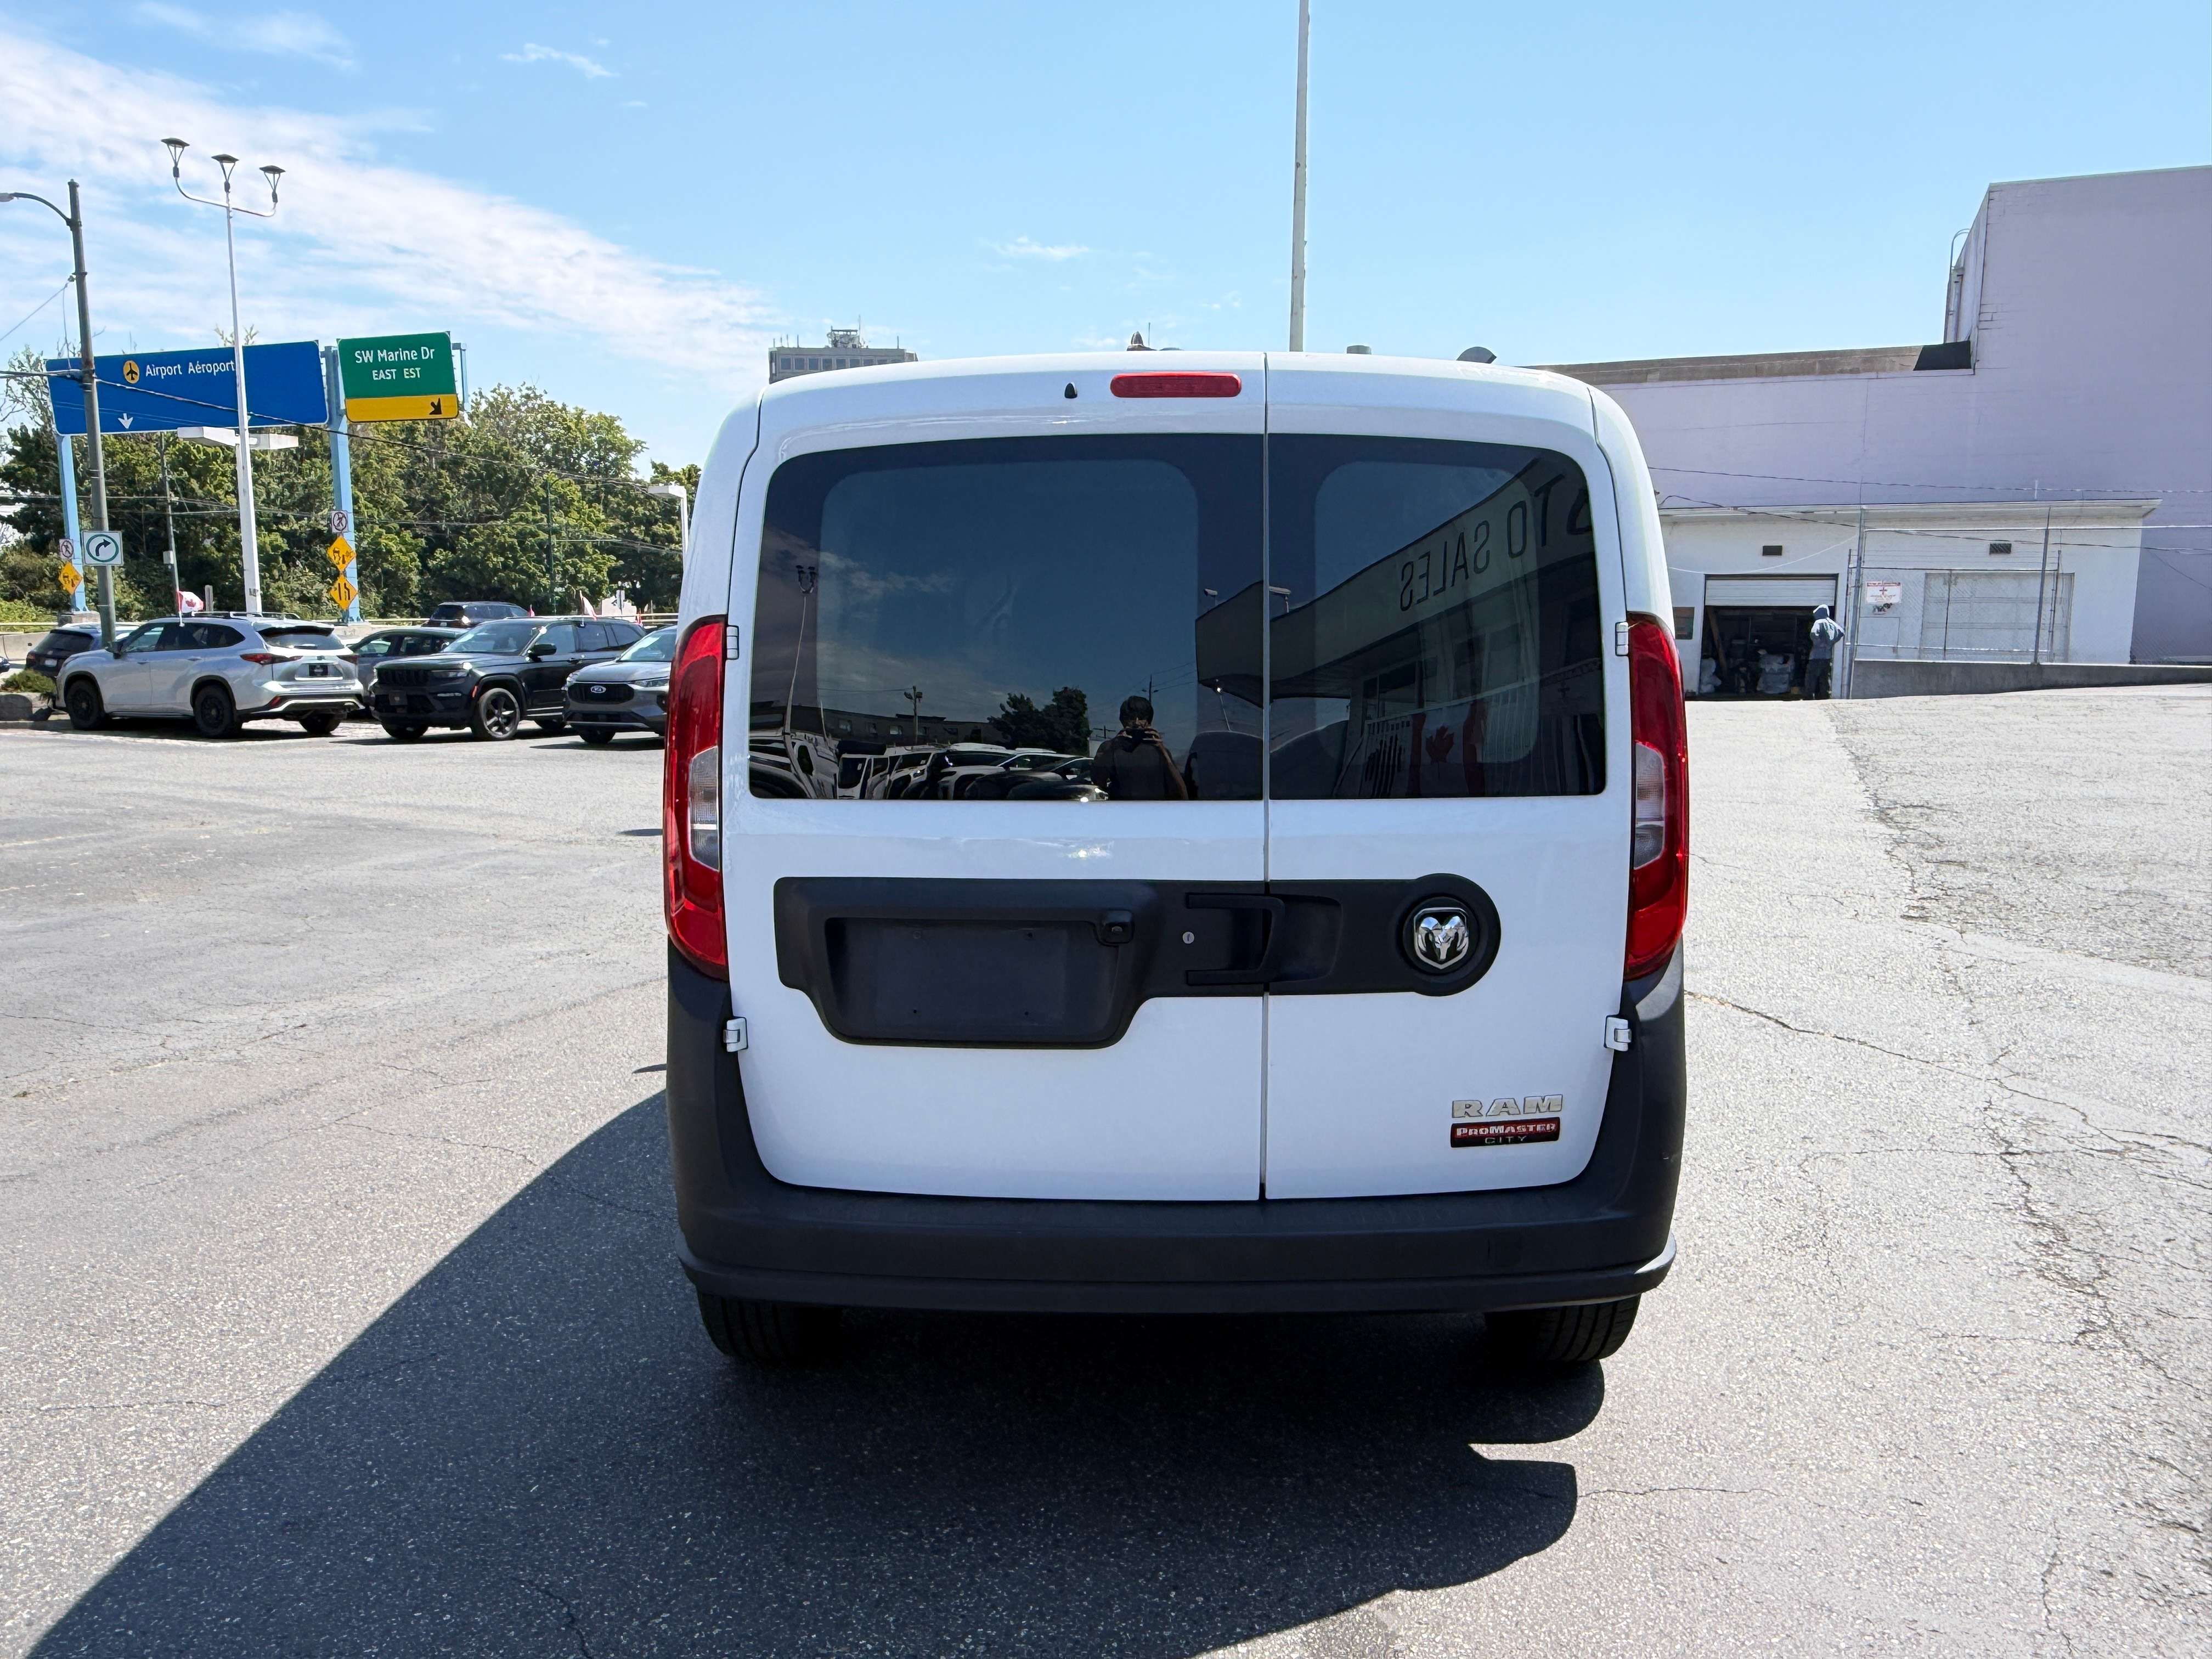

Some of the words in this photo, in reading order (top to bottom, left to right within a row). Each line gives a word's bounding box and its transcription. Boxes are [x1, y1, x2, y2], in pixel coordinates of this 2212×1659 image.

[354, 350, 374, 363] SW
[377, 348, 417, 362] Marine
[421, 346, 435, 359] Dr
[145, 364, 183, 379] Airport
[188, 360, 235, 376] Aéroport
[372, 369, 397, 380] EAST
[403, 368, 421, 378] EST
[1452, 1094, 1563, 1118] RAM
[1485, 1135, 1527, 1144] CITY
